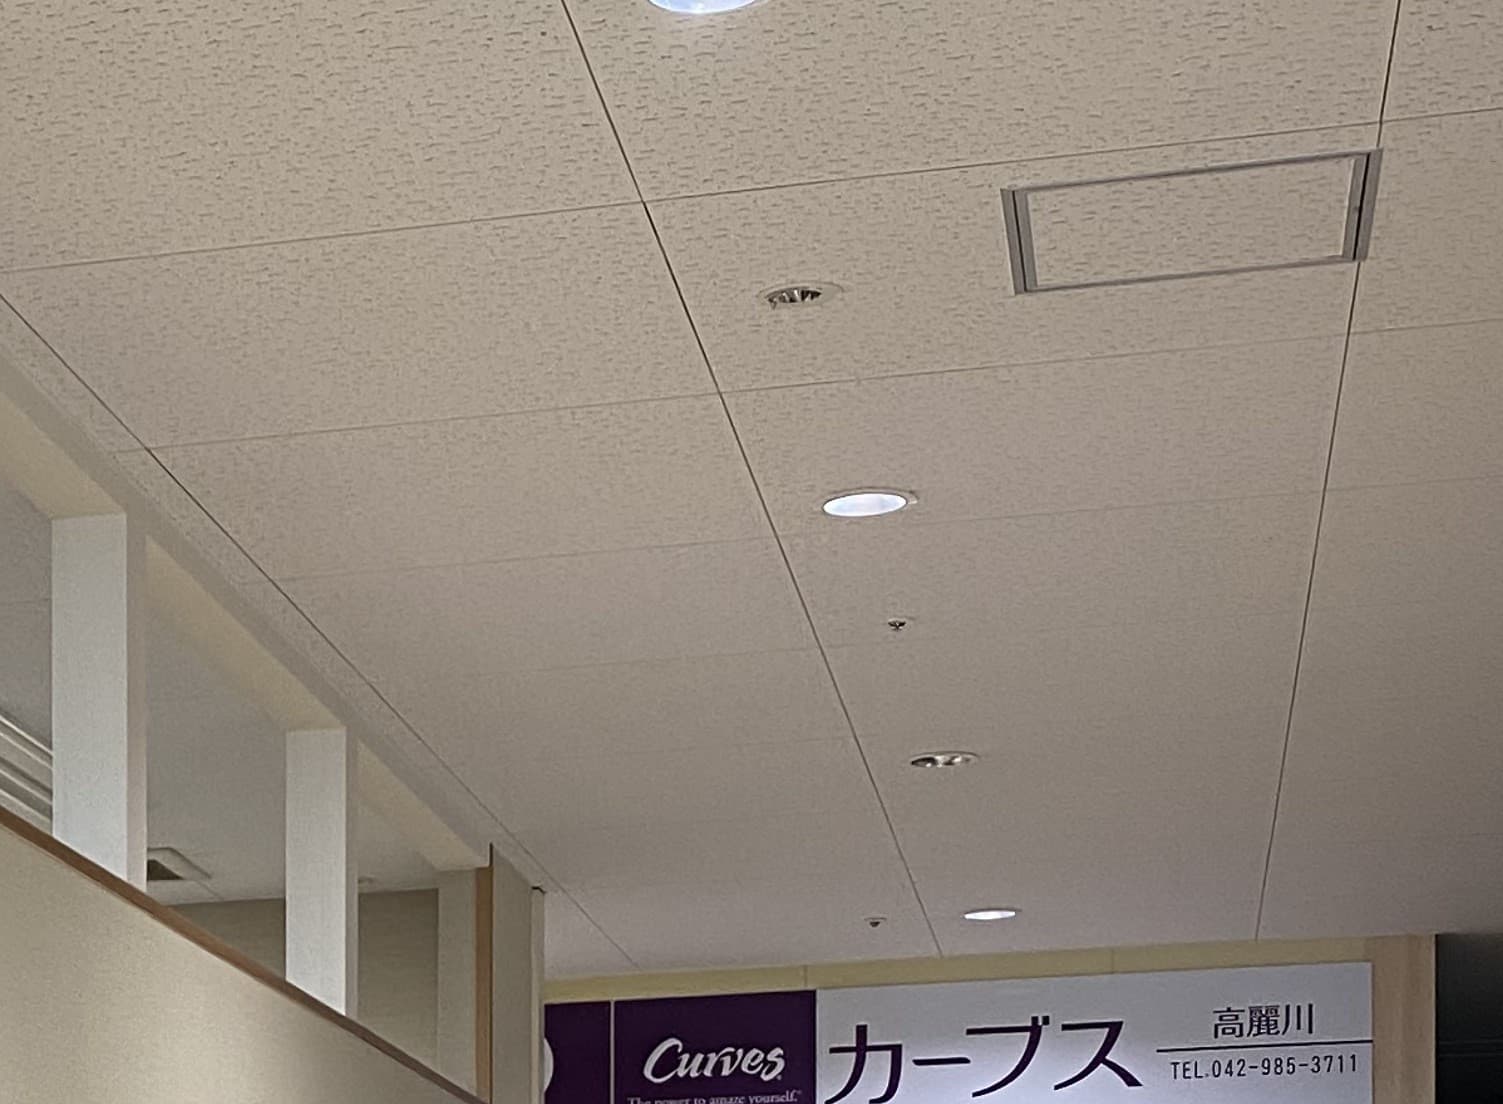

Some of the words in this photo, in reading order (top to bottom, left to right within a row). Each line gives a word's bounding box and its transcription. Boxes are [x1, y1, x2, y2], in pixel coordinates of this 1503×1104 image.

[1213, 1003, 1314, 1039] 高麗川
[643, 1037, 786, 1084] Curves
[1170, 1053, 1358, 1080] TEL.042-985-3711
